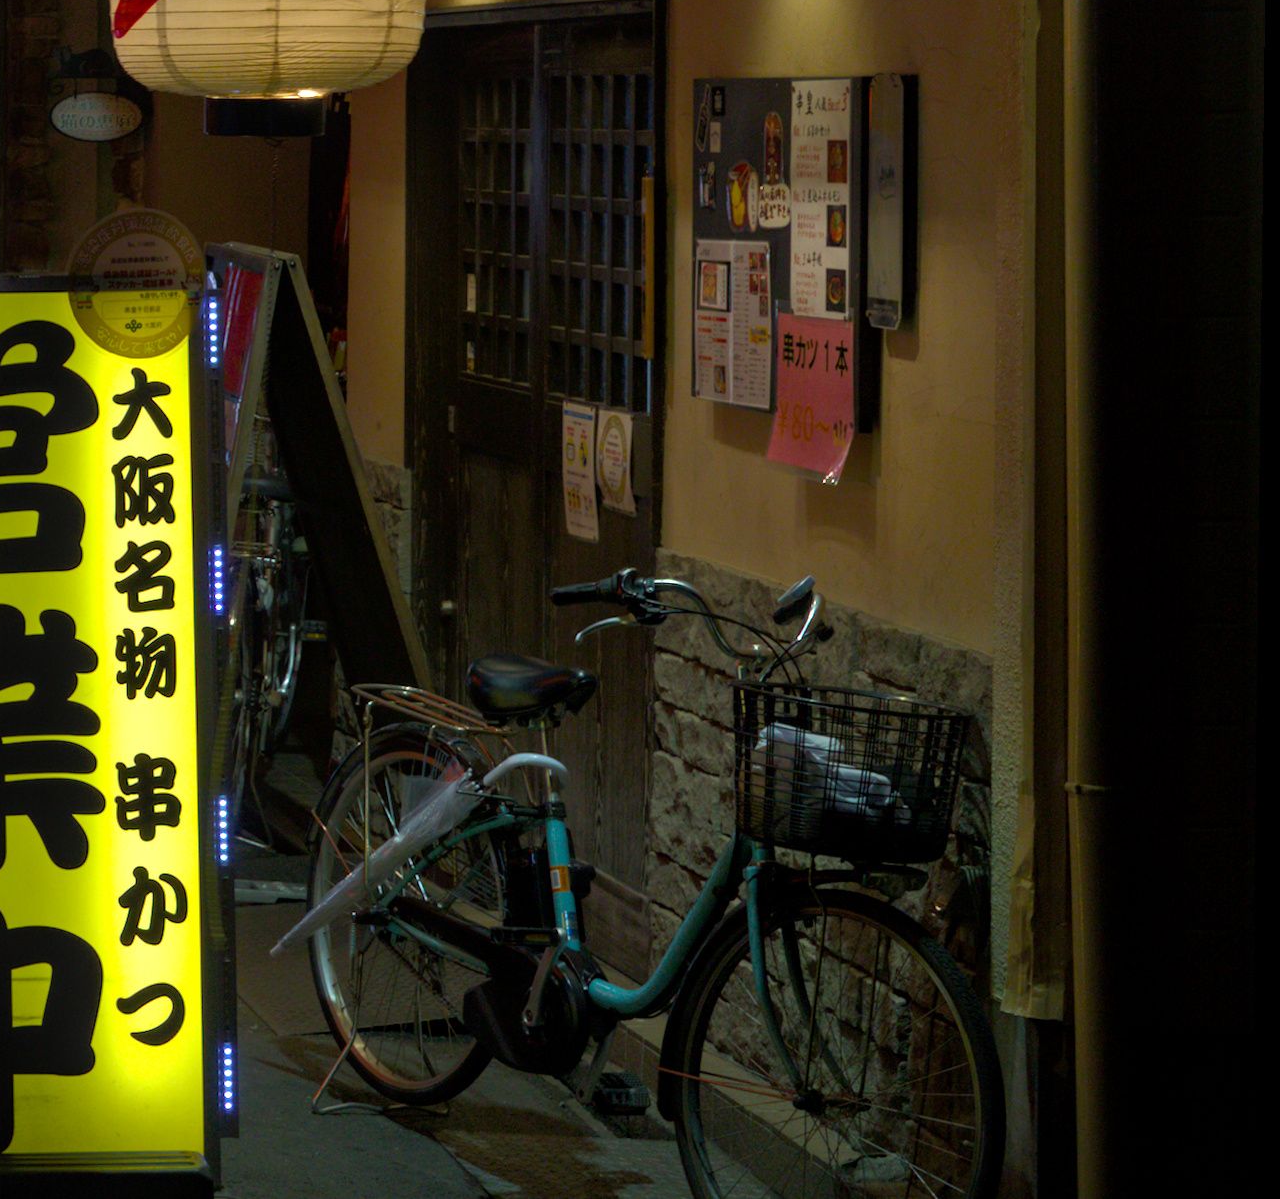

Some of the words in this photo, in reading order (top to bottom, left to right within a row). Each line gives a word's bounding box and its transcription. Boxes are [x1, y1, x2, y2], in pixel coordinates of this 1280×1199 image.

[111, 365, 178, 701] 大阪名物
[113, 753, 188, 1047] 串かつ
